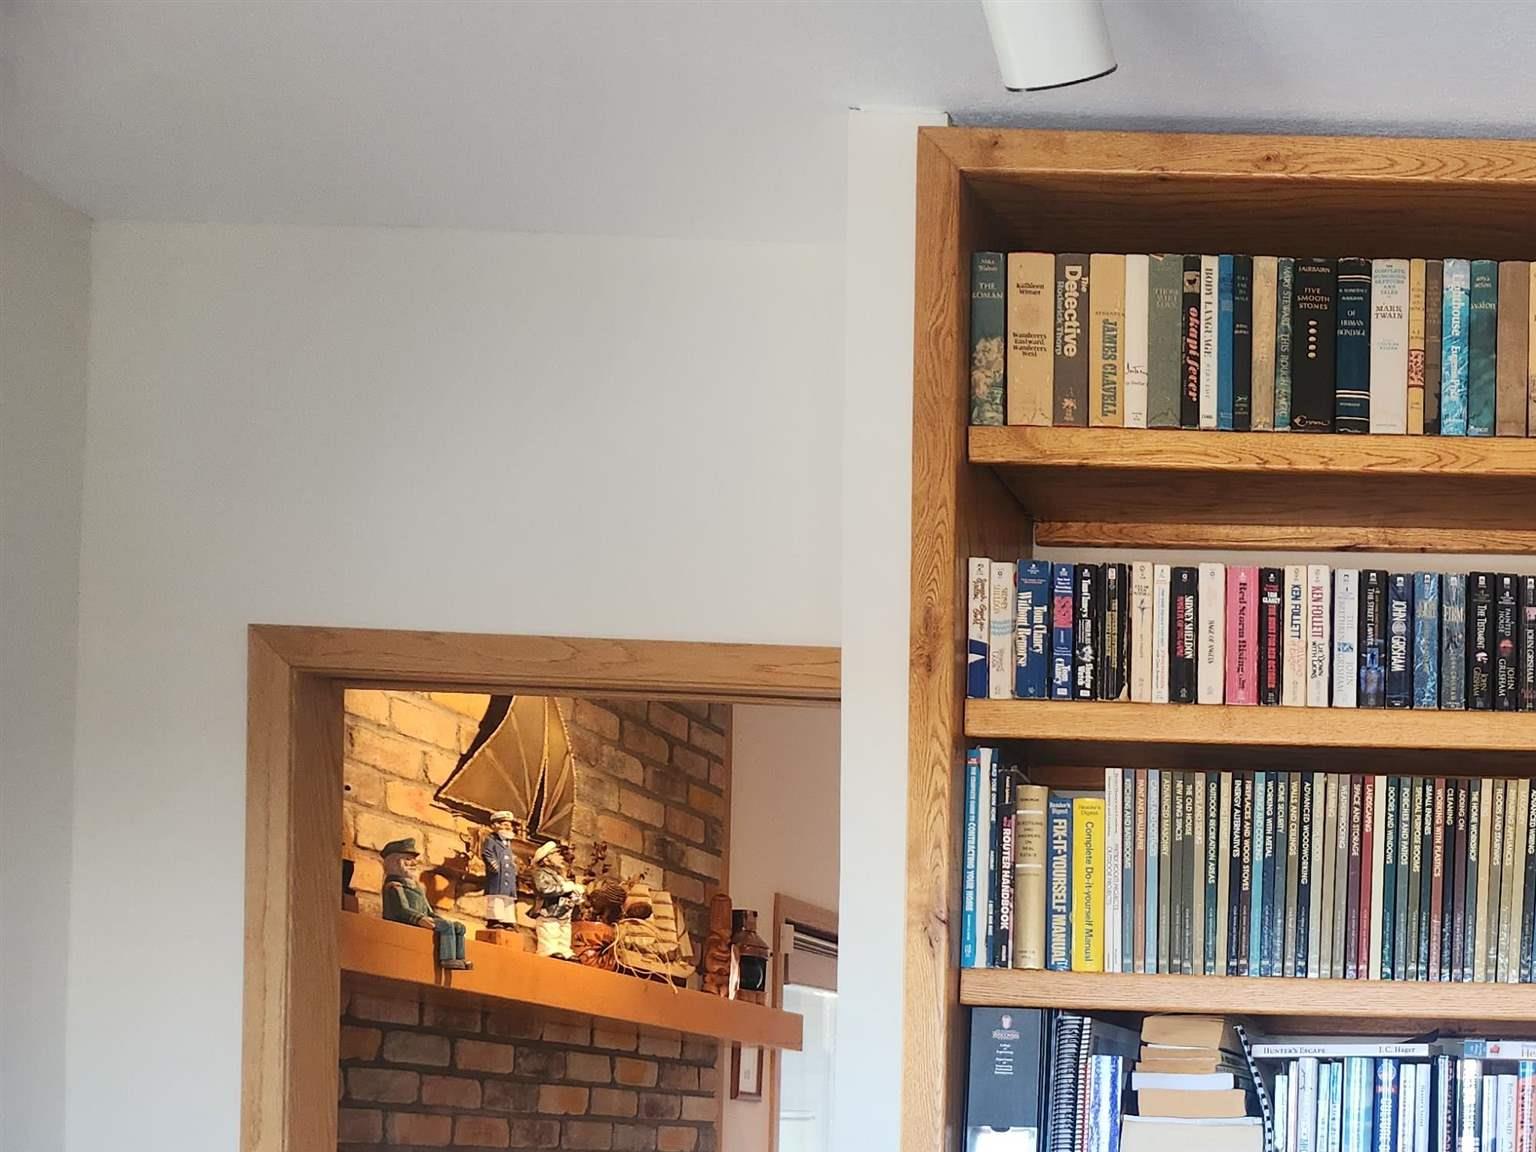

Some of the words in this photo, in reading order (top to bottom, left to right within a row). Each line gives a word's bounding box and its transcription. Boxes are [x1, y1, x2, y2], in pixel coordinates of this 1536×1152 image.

[1205, 268, 1213, 298] BODY
[1064, 266, 1082, 357] Detective
[1102, 319, 1117, 360] JAMES
[1205, 301, 1213, 358] LANGUAGE
[1102, 364, 1117, 416] CLAVELL
[1017, 592, 1031, 626] Without
[1238, 582, 1247, 604] Red
[1291, 584, 1301, 601] KEN
[1033, 606, 1047, 623] Tom
[1185, 596, 1193, 623] SIDNEY
[1238, 606, 1246, 638] Storm
[1291, 604, 1301, 639] FOLLETT
[1392, 600, 1406, 622] JOHN
[1477, 605, 1487, 617] THE
[1017, 627, 1031, 667] Remorse
[1030, 625, 1047, 654] Clancy
[1184, 623, 1193, 659] SHELDON
[1476, 619, 1486, 649] TESTAMENT
[1237, 640, 1247, 673] Rising
[1391, 635, 1405, 672] GRISHAM
[1498, 659, 1506, 696] GRISHAM
[1175, 780, 1183, 795] NEW
[1233, 780, 1241, 807] ENERGY
[1243, 780, 1251, 817] FIREPLACES
[1266, 781, 1274, 817] WORKING
[1277, 782, 1285, 804] HOME
[1302, 782, 1311, 822] ADVANCED
[1353, 784, 1361, 807] SPACE
[1458, 789, 1466, 817] ADDING
[1277, 804, 1285, 834] SECURITY
[1352, 808, 1360, 823] AND
[1435, 788, 1443, 824] WORKING
[1446, 788, 1454, 826] CLEANING
[1232, 808, 1240, 857] ALTERNATIVES
[1351, 824, 1360, 856] STORAGE
[1434, 827, 1442, 843] WITH
[1458, 819, 1465, 830] ON
[1001, 828, 1012, 869] ROUTER
[1084, 821, 1094, 864] Complete
[1242, 838, 1250, 863] WOOD
[1301, 825, 1310, 884] WOODWORKING
[1052, 819, 1067, 912] FIX-IT-YOURSELF
[1000, 870, 1011, 930] HANDBOOK
[1083, 867, 1093, 926] Do-it-yourself
[1051, 914, 1066, 966] MANUAL
[1084, 929, 1093, 962] Manual
